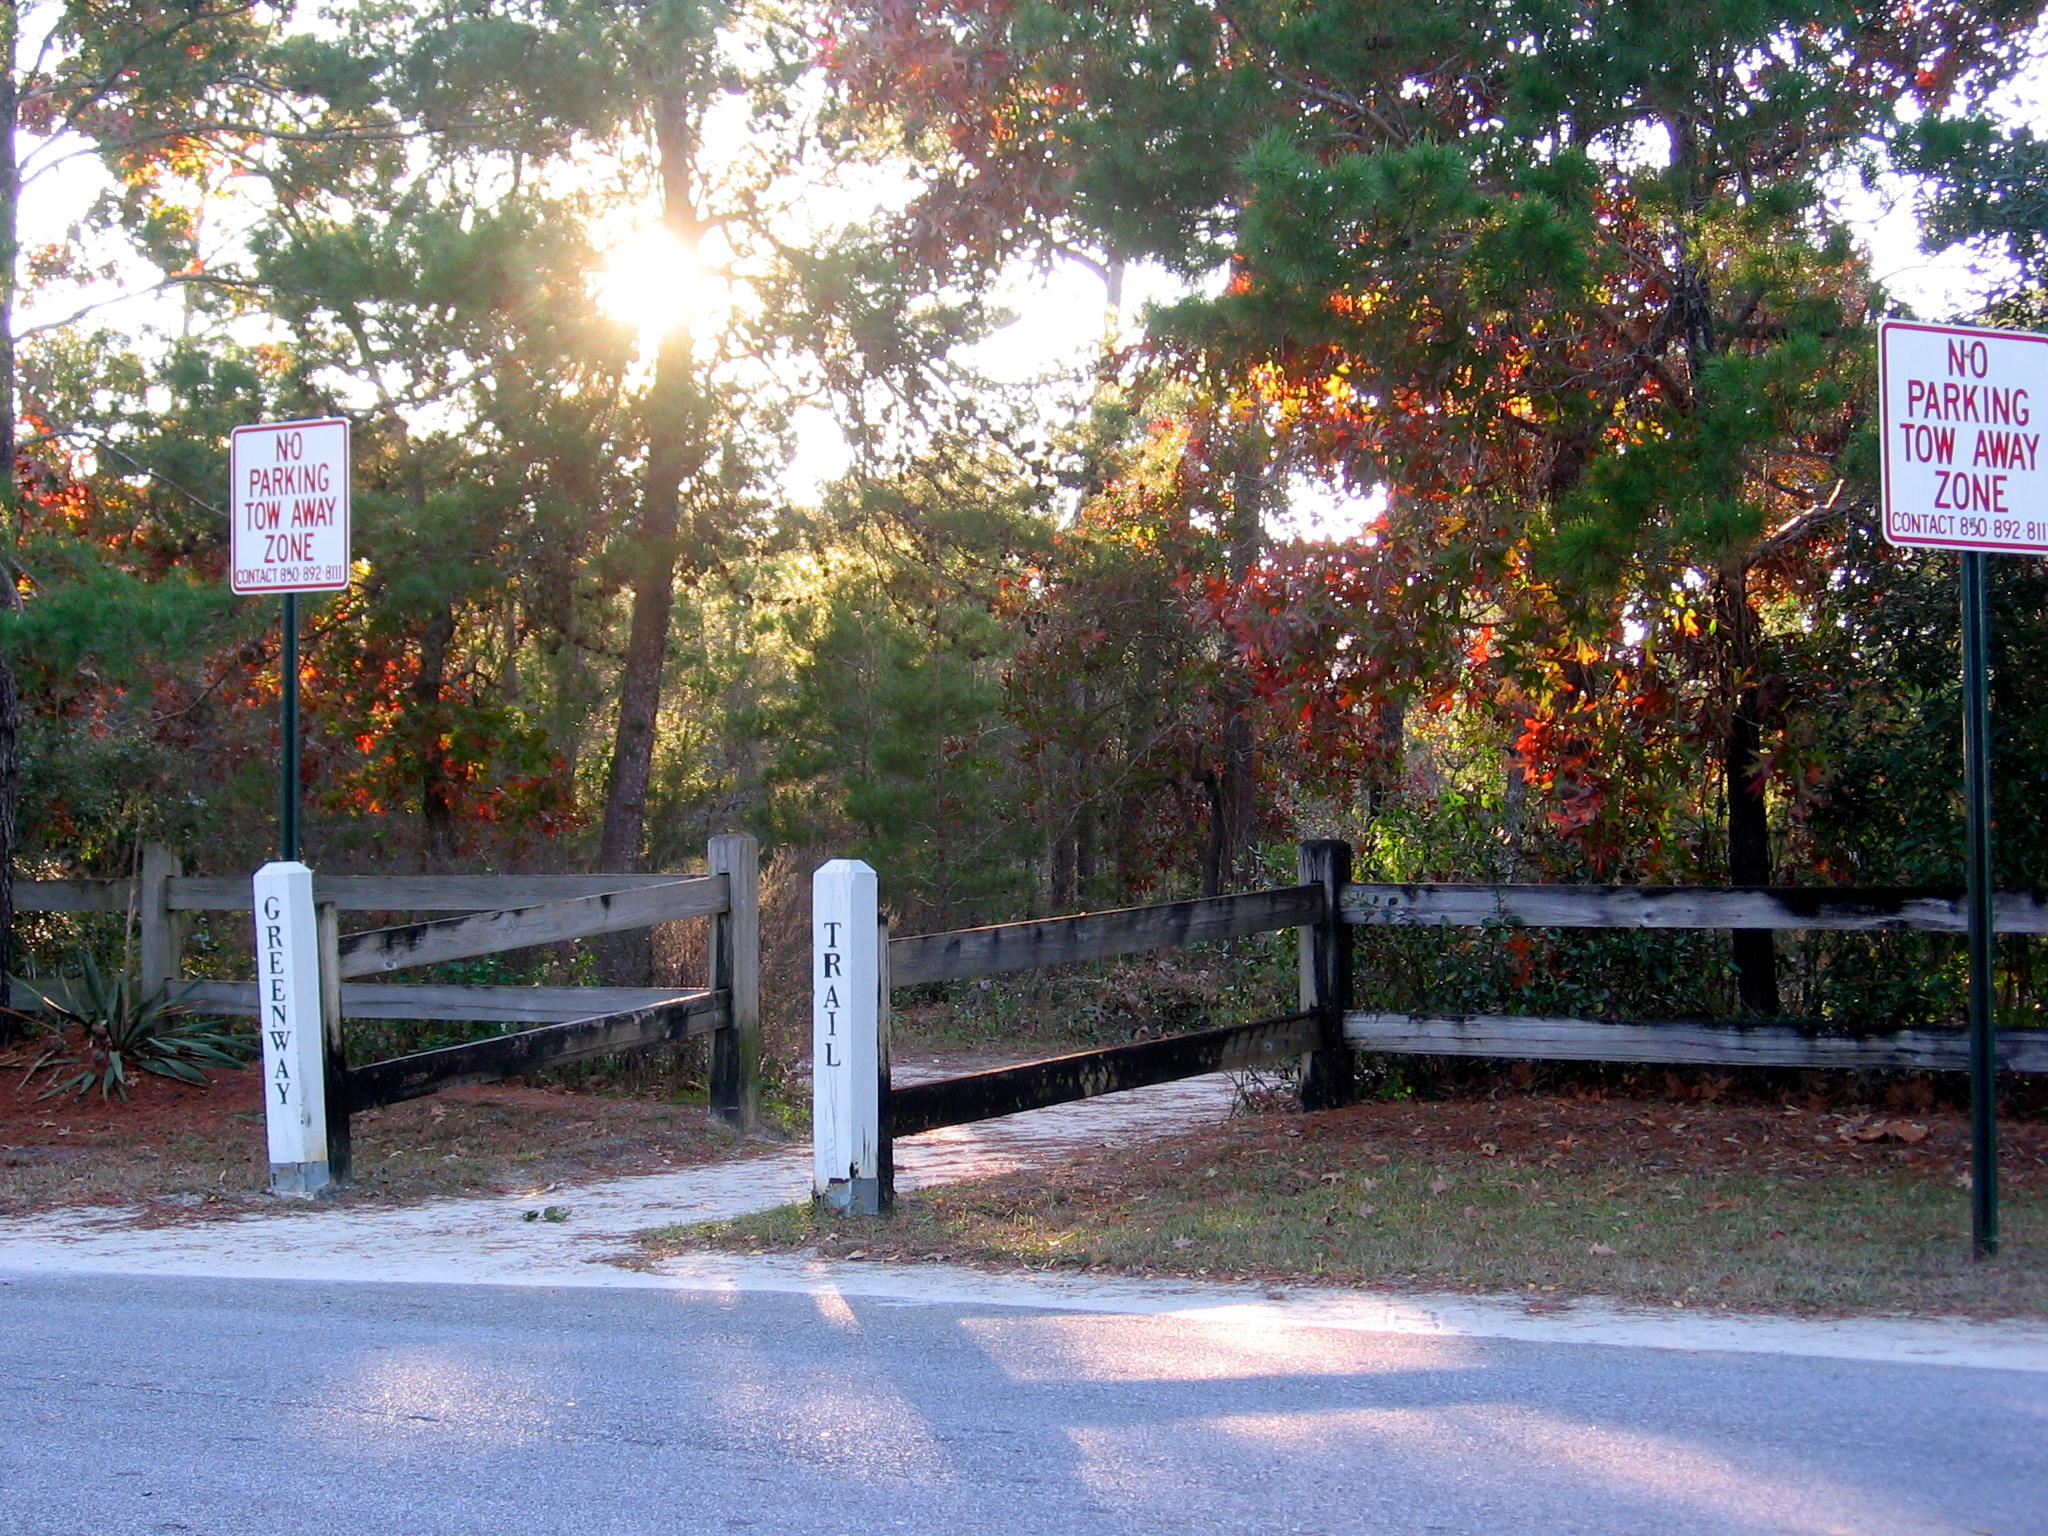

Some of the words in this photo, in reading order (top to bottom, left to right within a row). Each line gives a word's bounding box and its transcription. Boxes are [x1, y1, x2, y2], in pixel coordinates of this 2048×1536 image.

[1948, 338, 1988, 379] NO
[1907, 379, 2030, 427] PARKING
[276, 431, 303, 462] NO
[1899, 422, 1956, 465] TOW
[1972, 429, 2041, 471] AWAY
[249, 462, 329, 498] PARKING
[1934, 470, 2009, 513] ZONE
[244, 500, 282, 532] TOW
[290, 496, 337, 528] AWAY
[1892, 511, 1955, 536] CONTACT
[263, 532, 315, 564] ZONE
[236, 567, 278, 585] CONTACT
[264, 896, 292, 1105] GREENWAY
[822, 921, 842, 1068] TRAIL
